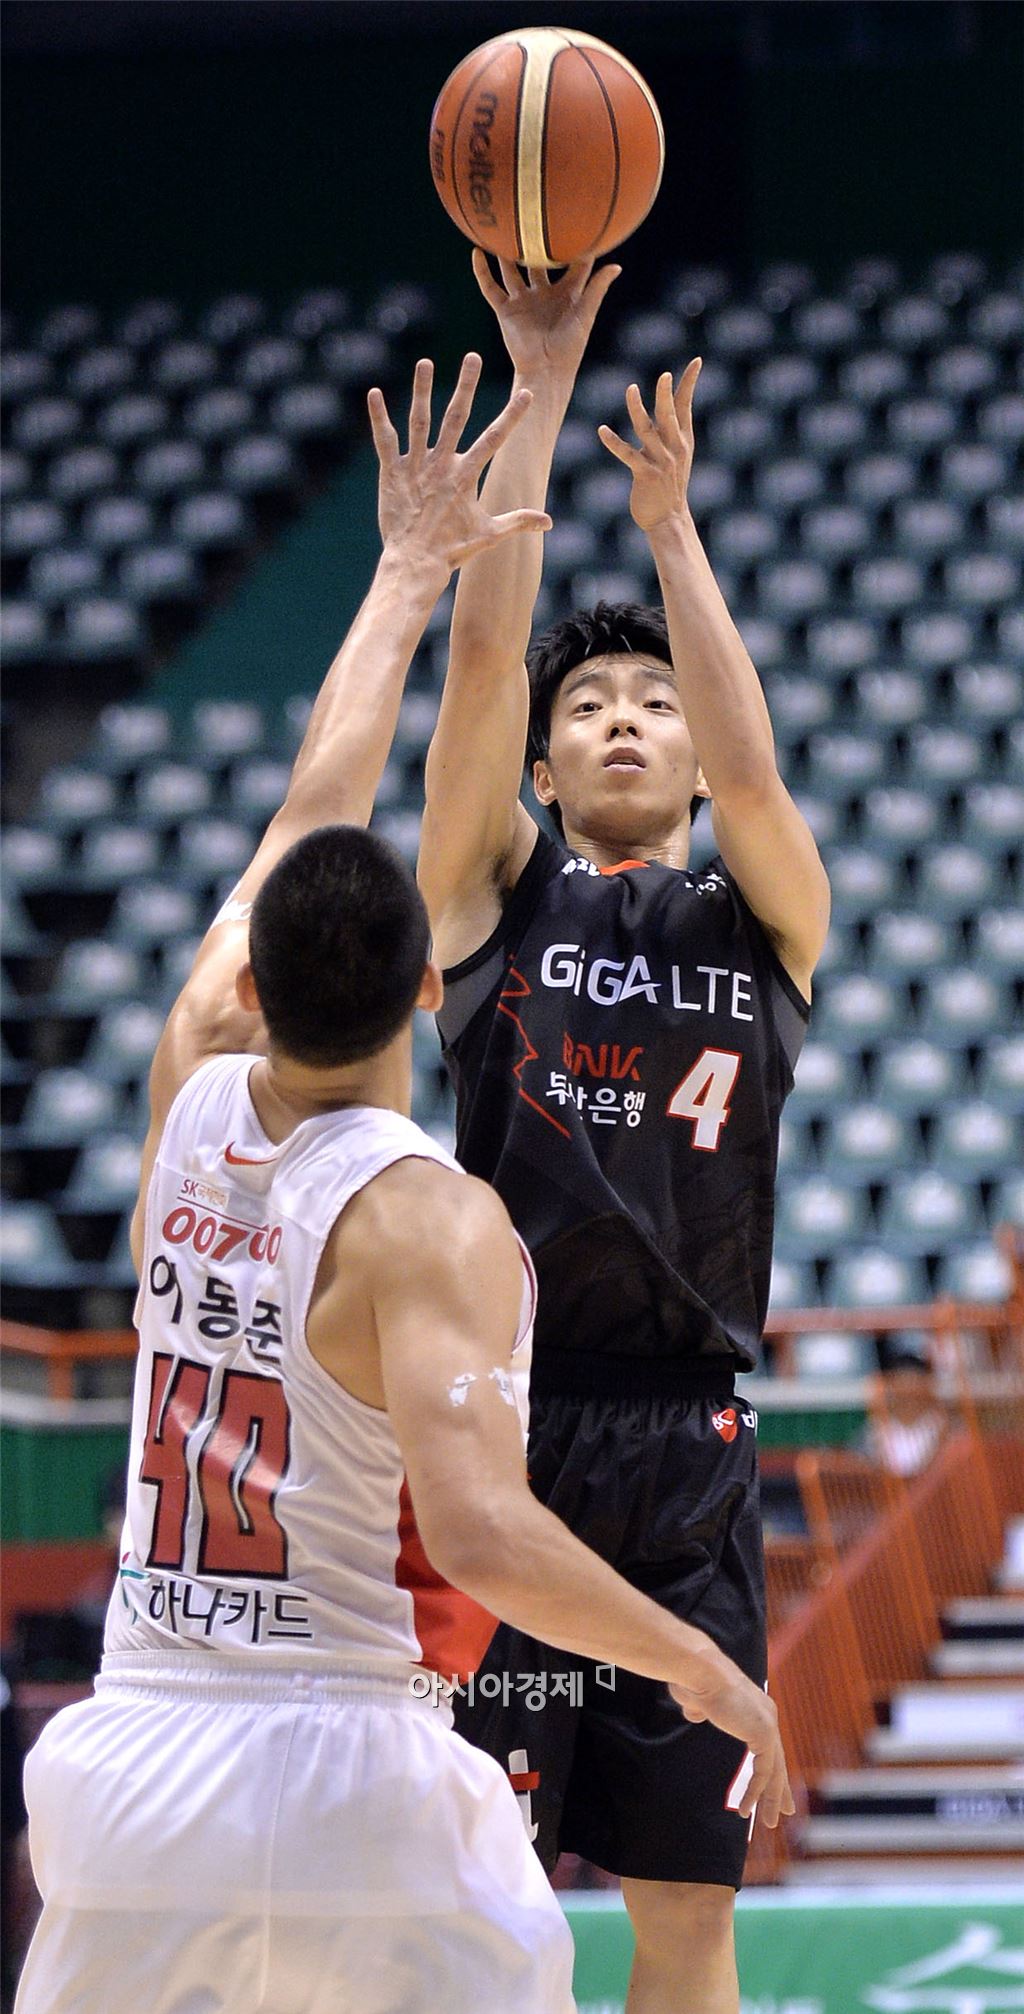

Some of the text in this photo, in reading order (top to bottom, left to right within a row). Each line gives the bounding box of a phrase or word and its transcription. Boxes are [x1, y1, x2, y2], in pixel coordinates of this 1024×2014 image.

[470, 91, 498, 227] molten
[672, 965, 753, 1021] LTE
[667, 1047, 742, 1152] 4
[162, 1207, 282, 1265] 00700
[151, 1255, 283, 1364] 이동준
[139, 1351, 291, 1581] 40
[149, 1580, 313, 1643] 하나카드
